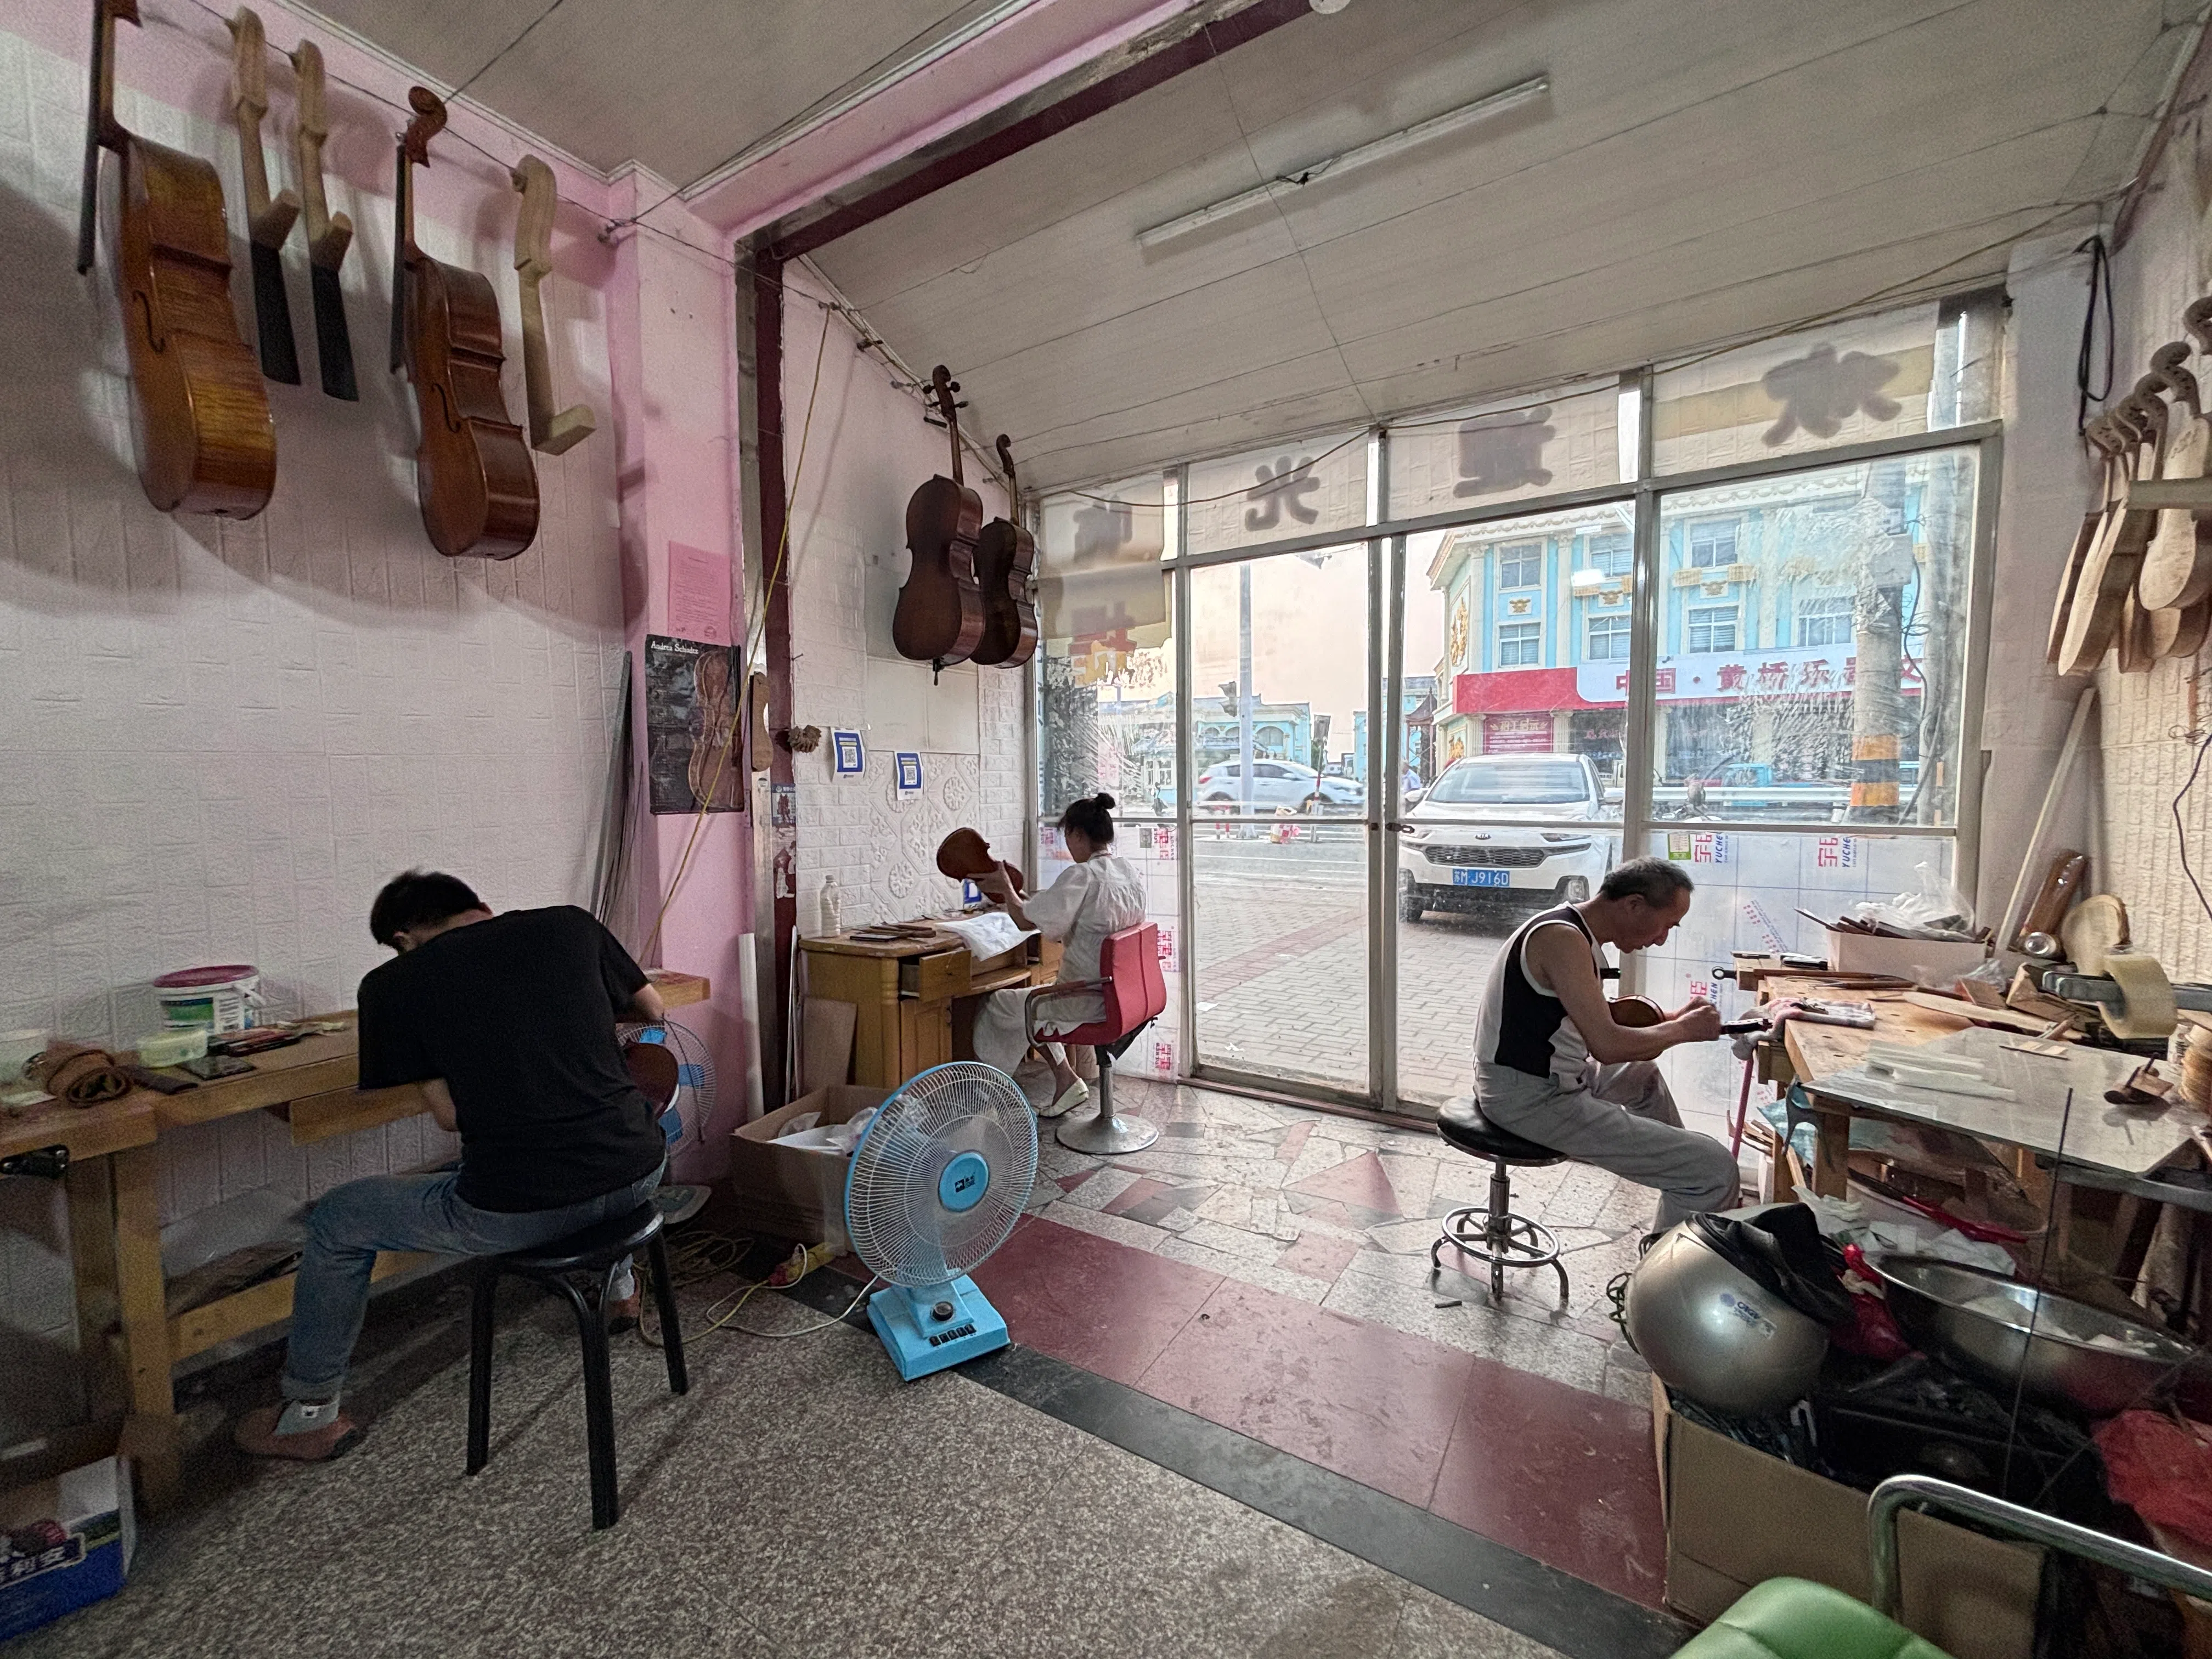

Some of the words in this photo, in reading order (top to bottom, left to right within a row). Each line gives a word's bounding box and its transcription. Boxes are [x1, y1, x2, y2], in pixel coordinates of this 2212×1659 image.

[651, 640, 673, 651] Andrea
[1715, 833, 1723, 863] YUCHE
[1842, 838, 1851, 867] YUCHE
